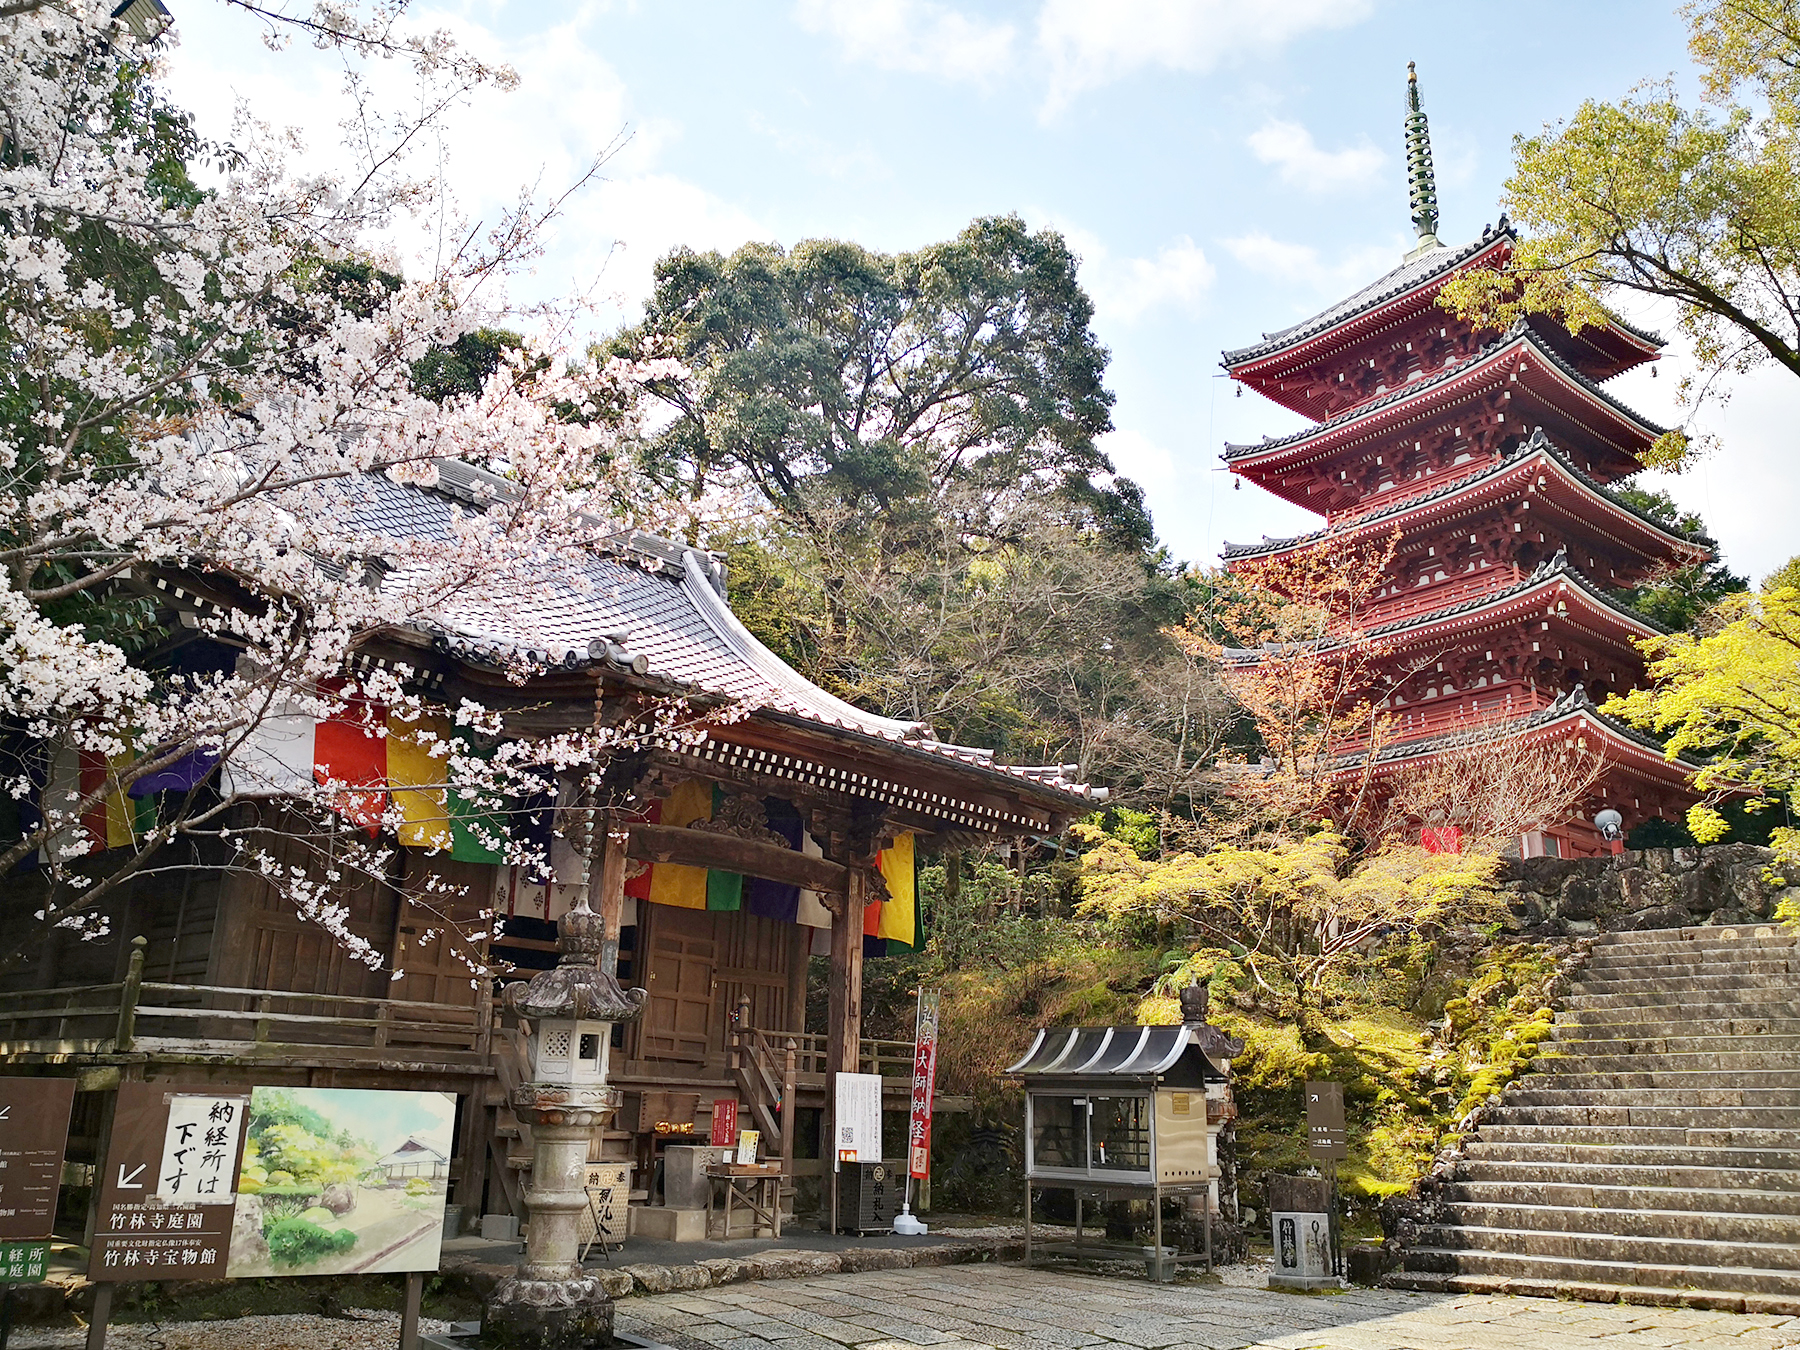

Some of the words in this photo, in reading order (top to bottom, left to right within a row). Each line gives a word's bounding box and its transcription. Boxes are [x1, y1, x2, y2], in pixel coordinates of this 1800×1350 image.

[911, 1005, 934, 1141] 弘法大師納経
[164, 1123, 198, 1195] 下です
[197, 1101, 235, 1194] 納経所は
[109, 1212, 204, 1230] 竹林寺庭園
[872, 1182, 885, 1223] 納札入
[0, 1247, 44, 1263] 経所
[103, 1248, 218, 1268] 竹林寺宝物館
[1282, 1220, 1295, 1267] 竹林寺
